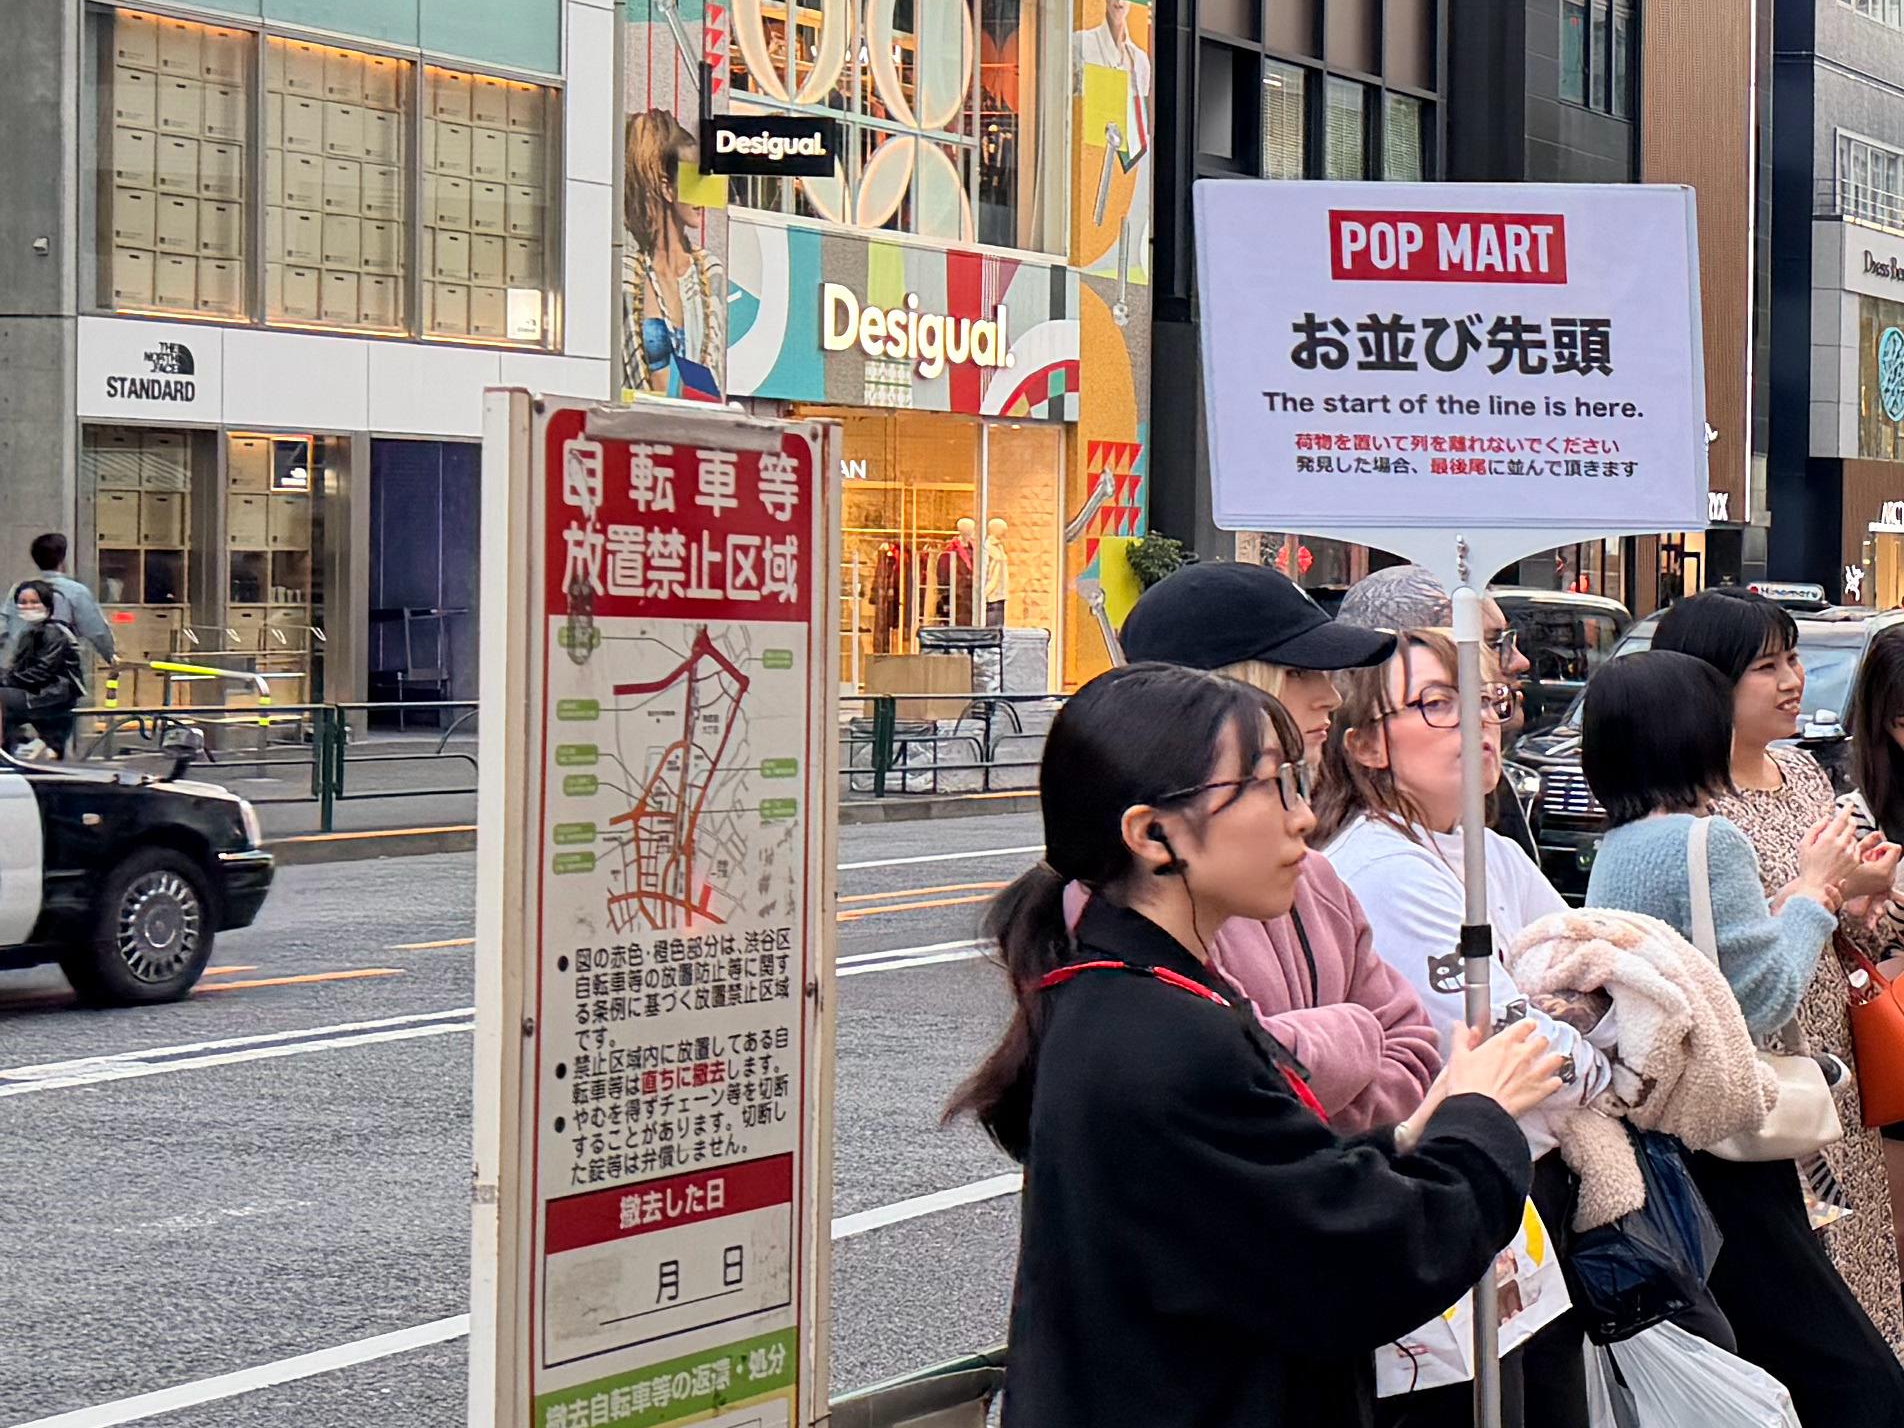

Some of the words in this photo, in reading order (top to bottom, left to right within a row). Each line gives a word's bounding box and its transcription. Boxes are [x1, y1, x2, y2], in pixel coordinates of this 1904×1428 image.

[715, 129, 827, 160] Desigual.
[1340, 220, 1424, 270] POP
[1436, 221, 1555, 273] MART
[158, 341, 179, 353] THE
[823, 282, 1016, 379] Desigual.
[1290, 311, 1614, 377] お並び先頭
[143, 351, 183, 363] NORTH
[150, 362, 179, 374] FACE
[106, 375, 195, 402] STANDARD
[1262, 390, 1314, 414] The
[1323, 393, 1391, 415] start
[1399, 393, 1428, 415] of
[1437, 393, 1480, 416] the
[1489, 394, 1536, 417] line
[1545, 395, 1567, 418] is
[1575, 397, 1645, 419] here.
[1295, 433, 1620, 455] 荷物を置いて列を離れないでください
[562, 433, 799, 522] 自転車等
[1296, 456, 1639, 479] 発見した場合、最後尾に並んで頂きます
[562, 520, 799, 604] 放置禁止区域
[575, 976, 790, 1024] る条例に基づく放置禁止区域
[574, 1026, 789, 1080] 禁止区域内に放置してある自
[575, 1026, 616, 1052] です。
[619, 1177, 725, 1230] 撤去した日
[655, 1259, 679, 1304] 月
[722, 1244, 744, 1286] 日
